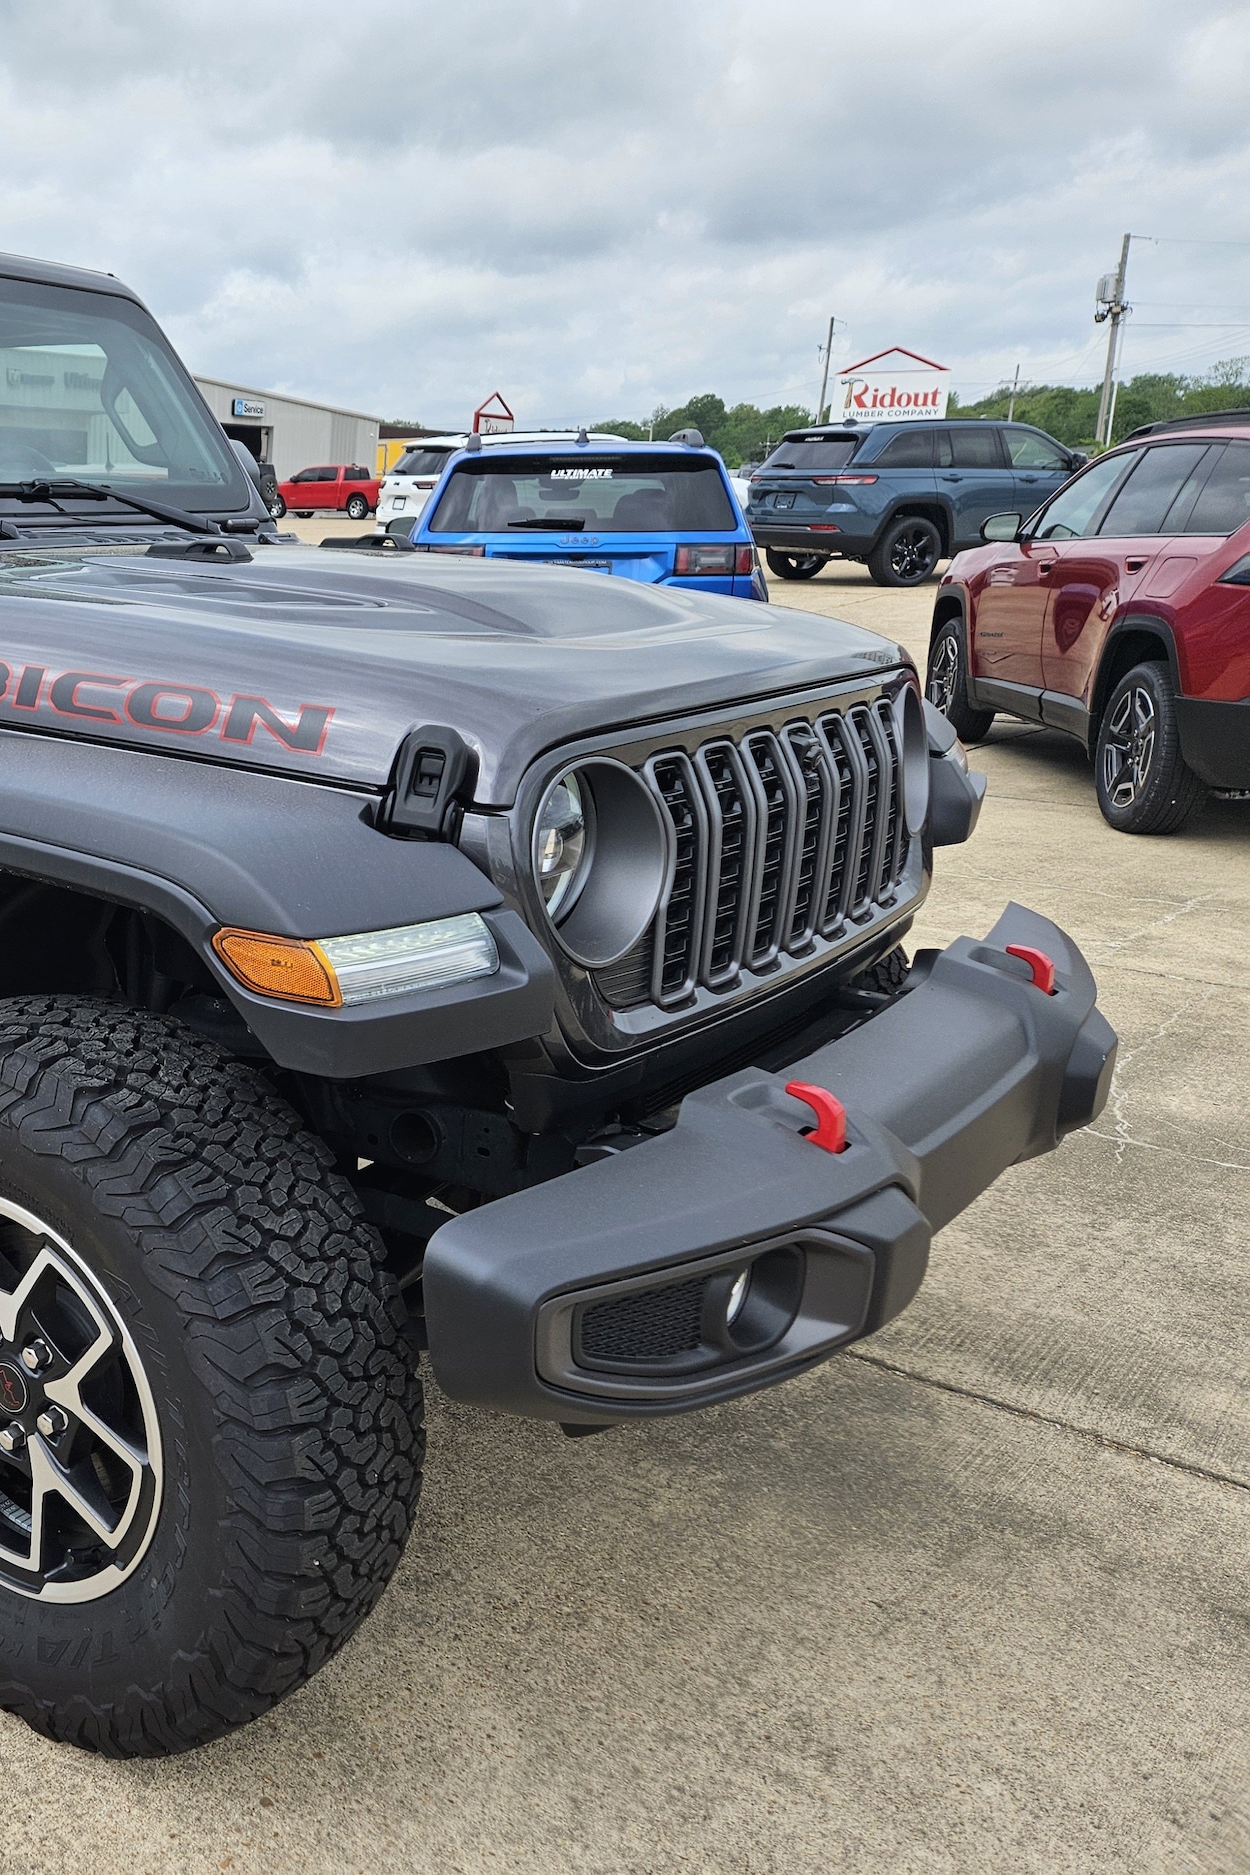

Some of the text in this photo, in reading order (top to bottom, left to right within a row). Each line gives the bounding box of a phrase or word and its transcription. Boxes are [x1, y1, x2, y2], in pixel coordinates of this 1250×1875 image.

[841, 378, 942, 409] Ridout
[243, 403, 264, 414] Service
[842, 408, 940, 418] LUMBER COMPANY
[550, 468, 613, 480] ULTIMATE
[560, 533, 600, 547] Jeep
